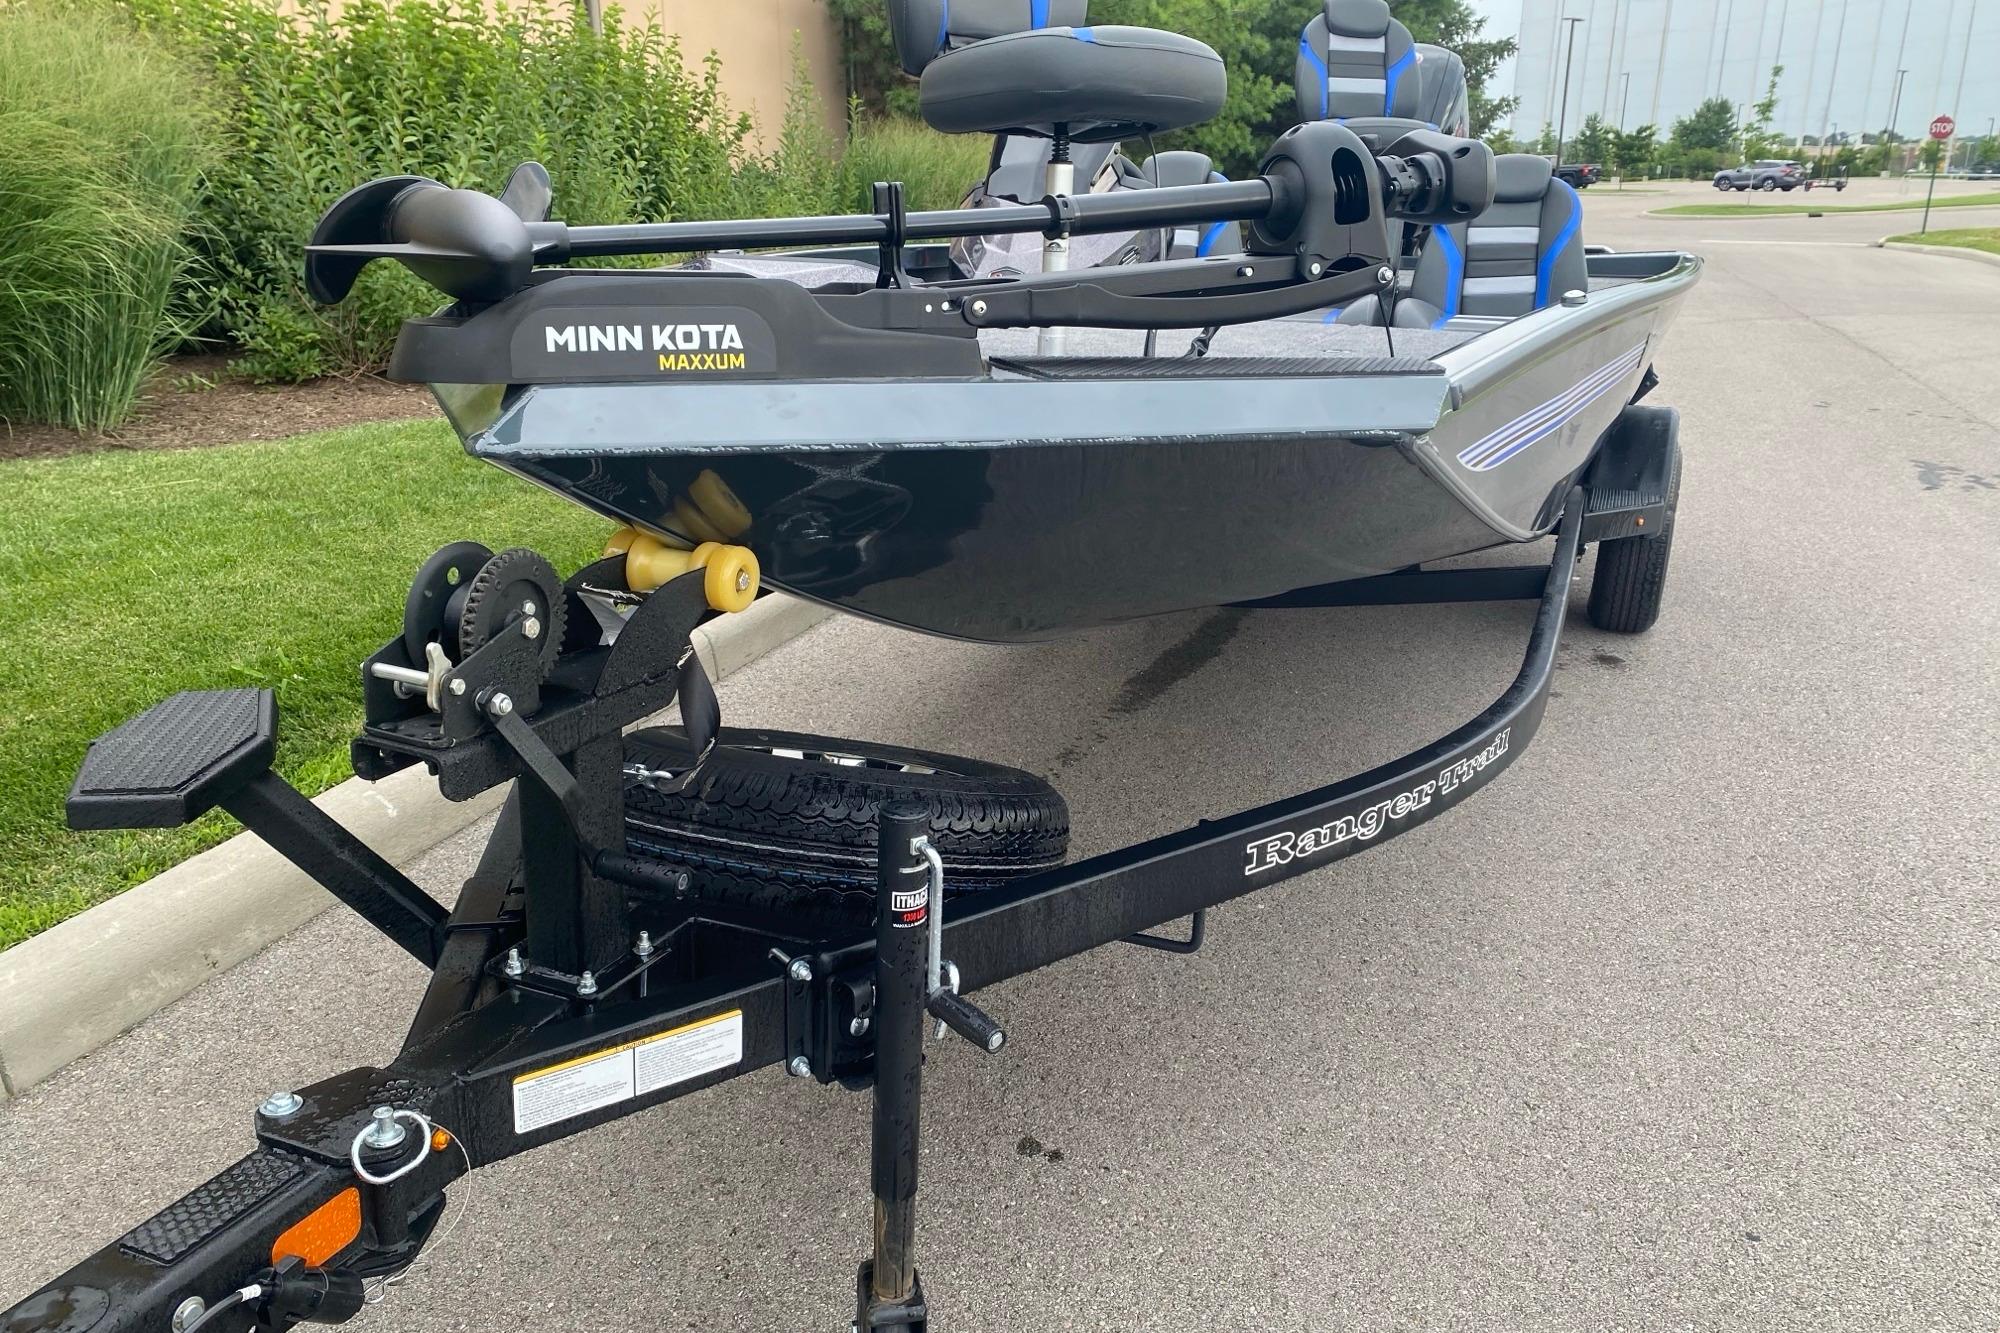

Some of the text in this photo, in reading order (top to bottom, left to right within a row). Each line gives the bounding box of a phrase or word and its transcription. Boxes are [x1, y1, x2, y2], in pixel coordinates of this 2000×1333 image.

[1931, 122, 1953, 133] STOP
[545, 324, 744, 352] MINN KOTA
[659, 353, 745, 371] MAXXUM
[1245, 728, 1511, 875] Ranger Trail
